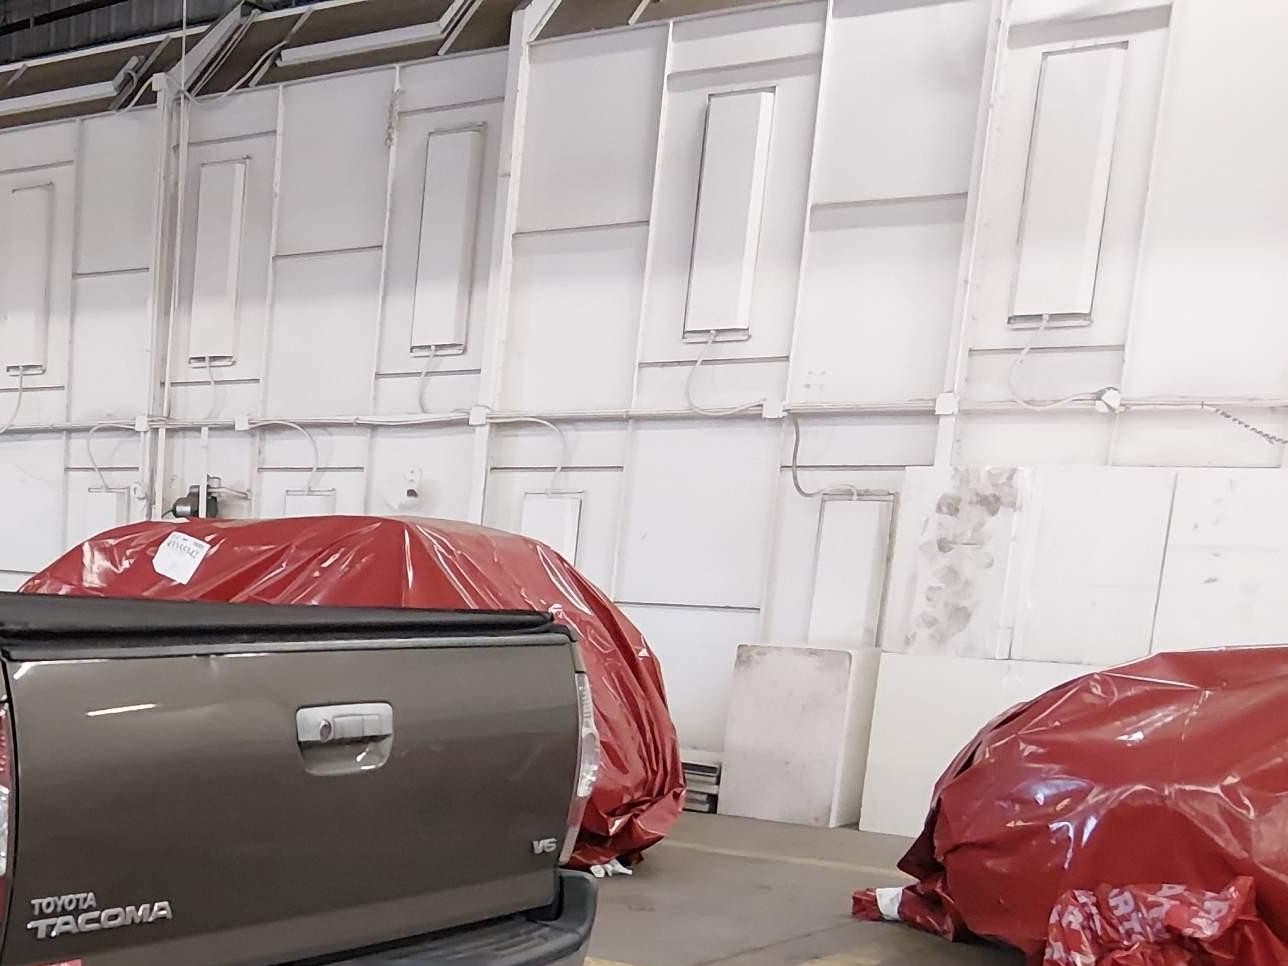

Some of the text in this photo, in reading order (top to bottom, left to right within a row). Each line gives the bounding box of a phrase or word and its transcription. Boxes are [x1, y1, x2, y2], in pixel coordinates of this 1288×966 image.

[532, 837, 557, 854] V6
[30, 892, 97, 916] TOYOTA
[26, 901, 173, 938] TACOMA
